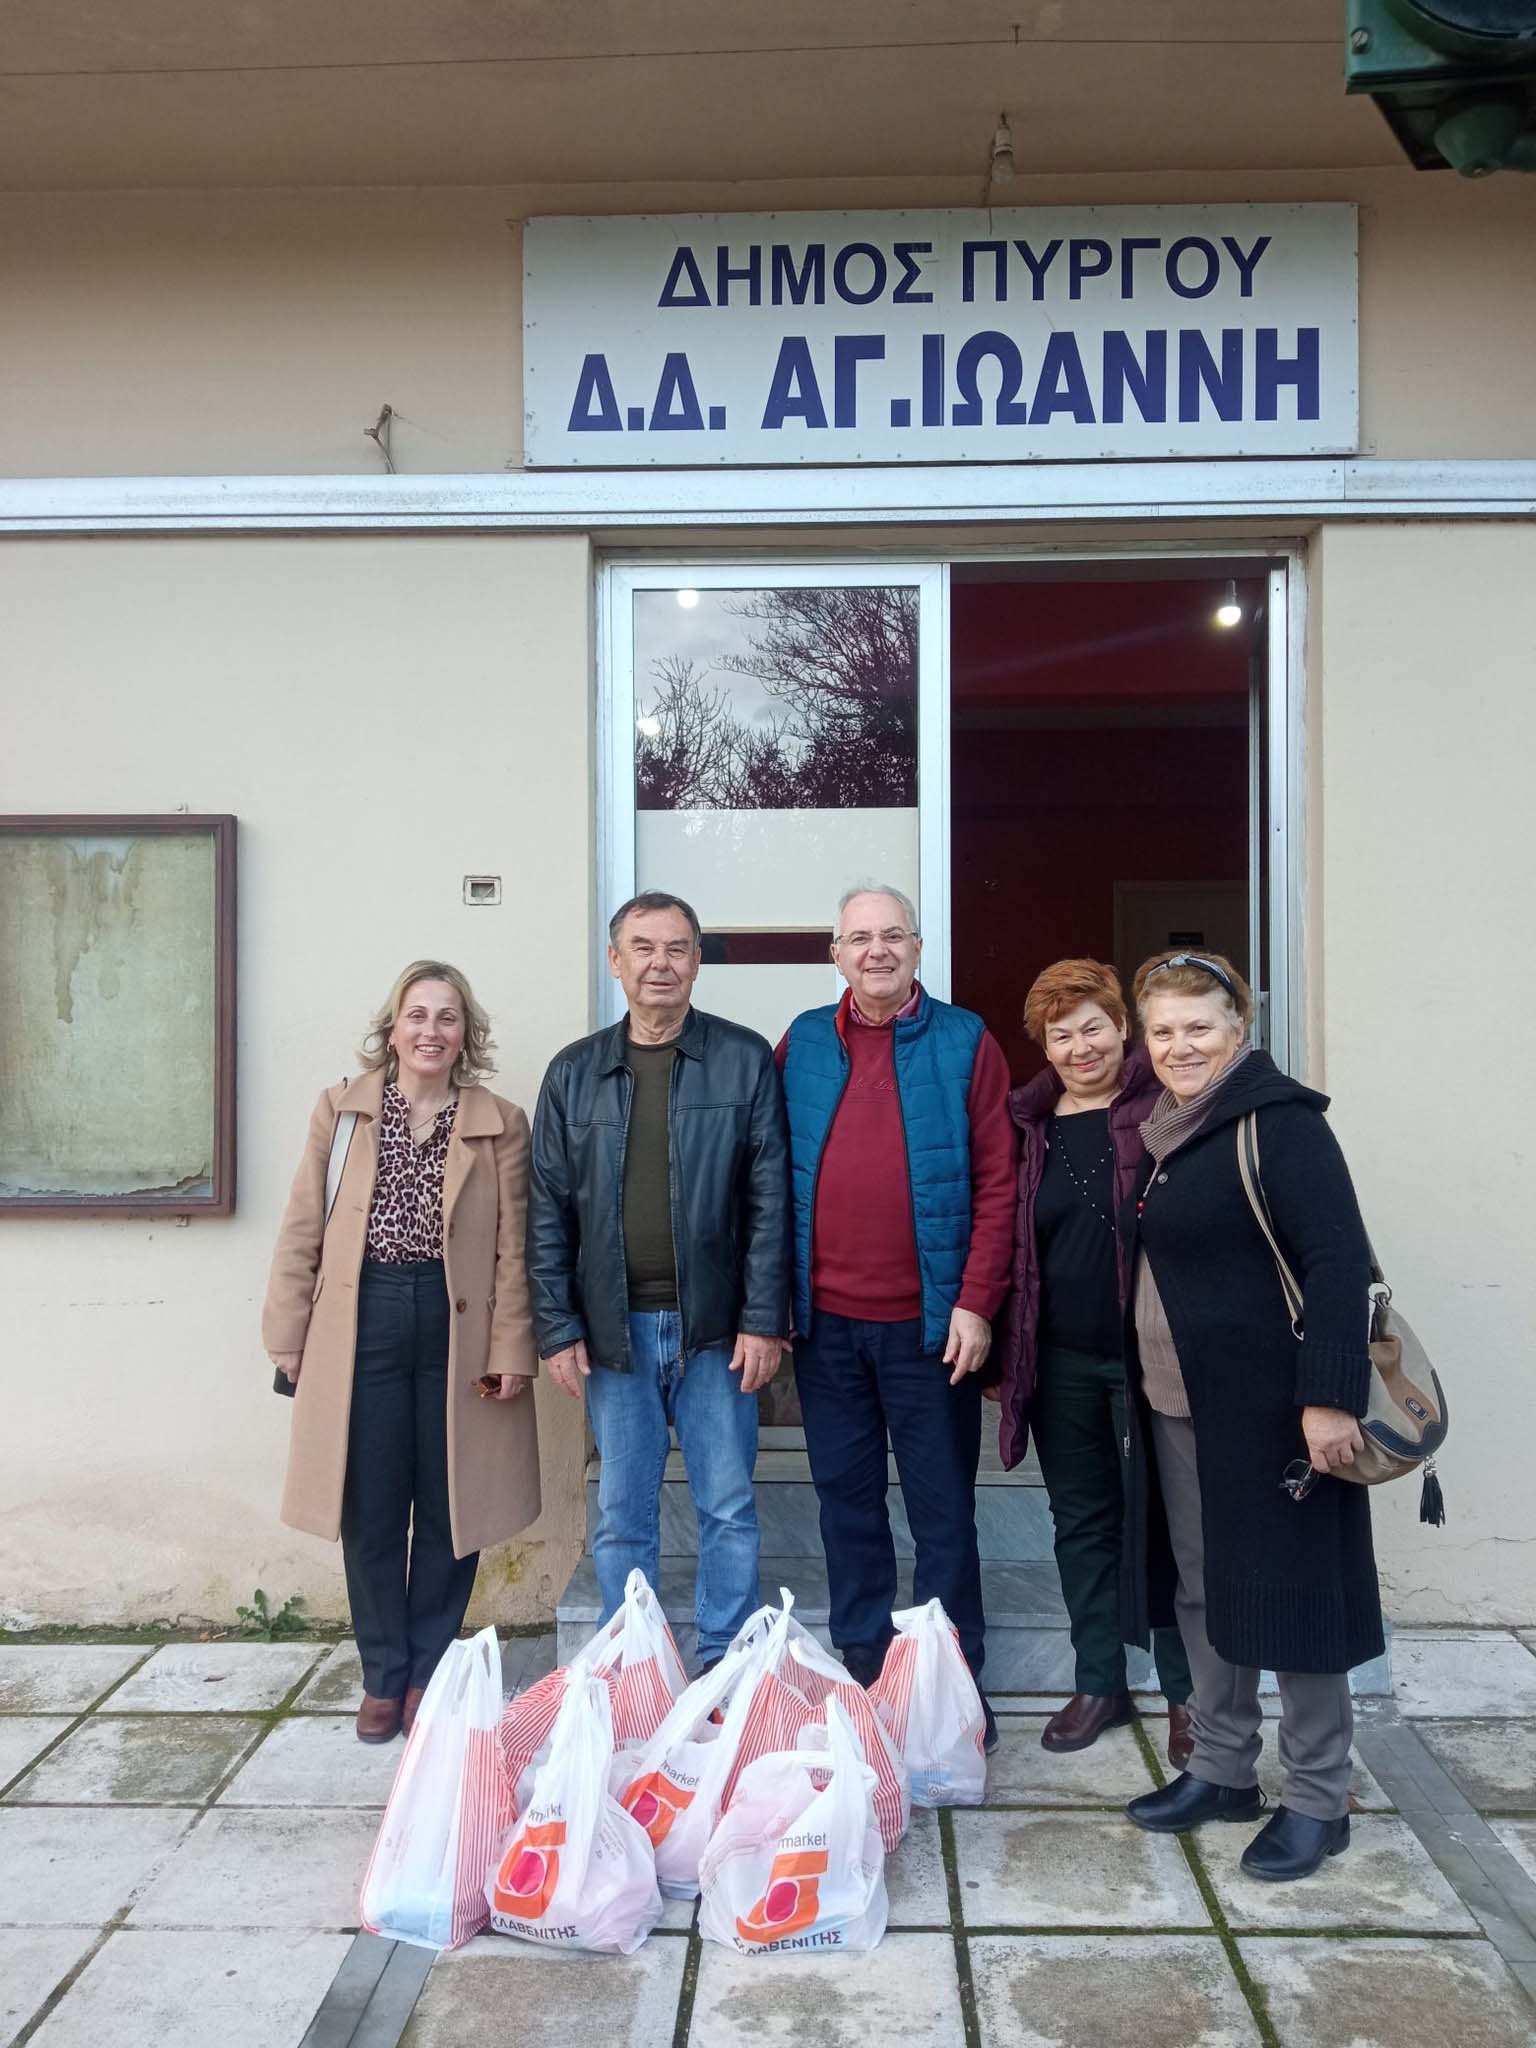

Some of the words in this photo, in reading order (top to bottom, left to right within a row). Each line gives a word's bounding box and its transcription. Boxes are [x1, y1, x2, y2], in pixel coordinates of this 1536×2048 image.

[658, 242, 934, 308] ΔΗΜΟΣ
[963, 236, 1272, 303] ΠΥΡΓΟΥ
[567, 353, 726, 432] Δ.Δ.
[761, 328, 1320, 429] ΑΓ.ΙΩΑΝΝΗ
